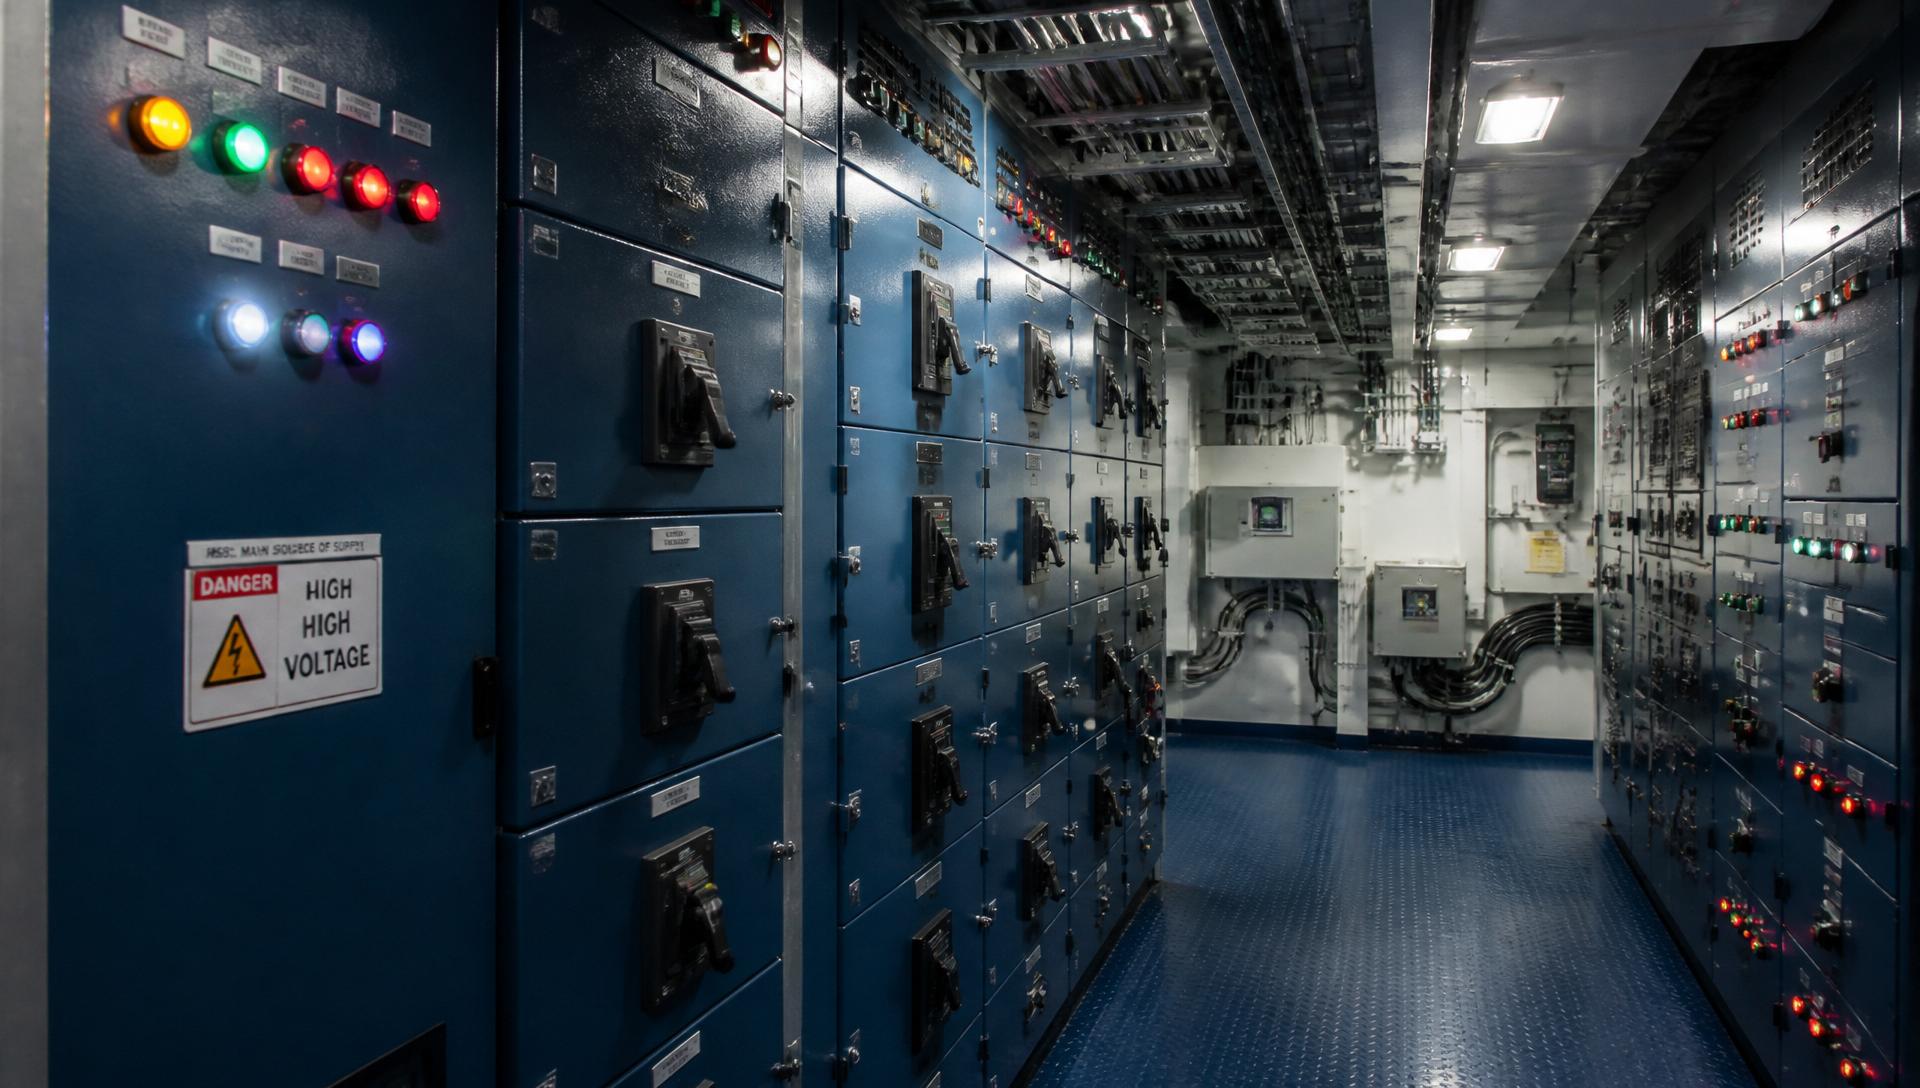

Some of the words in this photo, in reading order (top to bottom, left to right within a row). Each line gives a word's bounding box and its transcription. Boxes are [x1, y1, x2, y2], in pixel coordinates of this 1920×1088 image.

[318, 541, 331, 553] OF
[200, 573, 273, 596] DANGER
[306, 578, 352, 600] HIGH
[303, 610, 350, 638] HIGH
[284, 644, 370, 680] VOLTAGE
